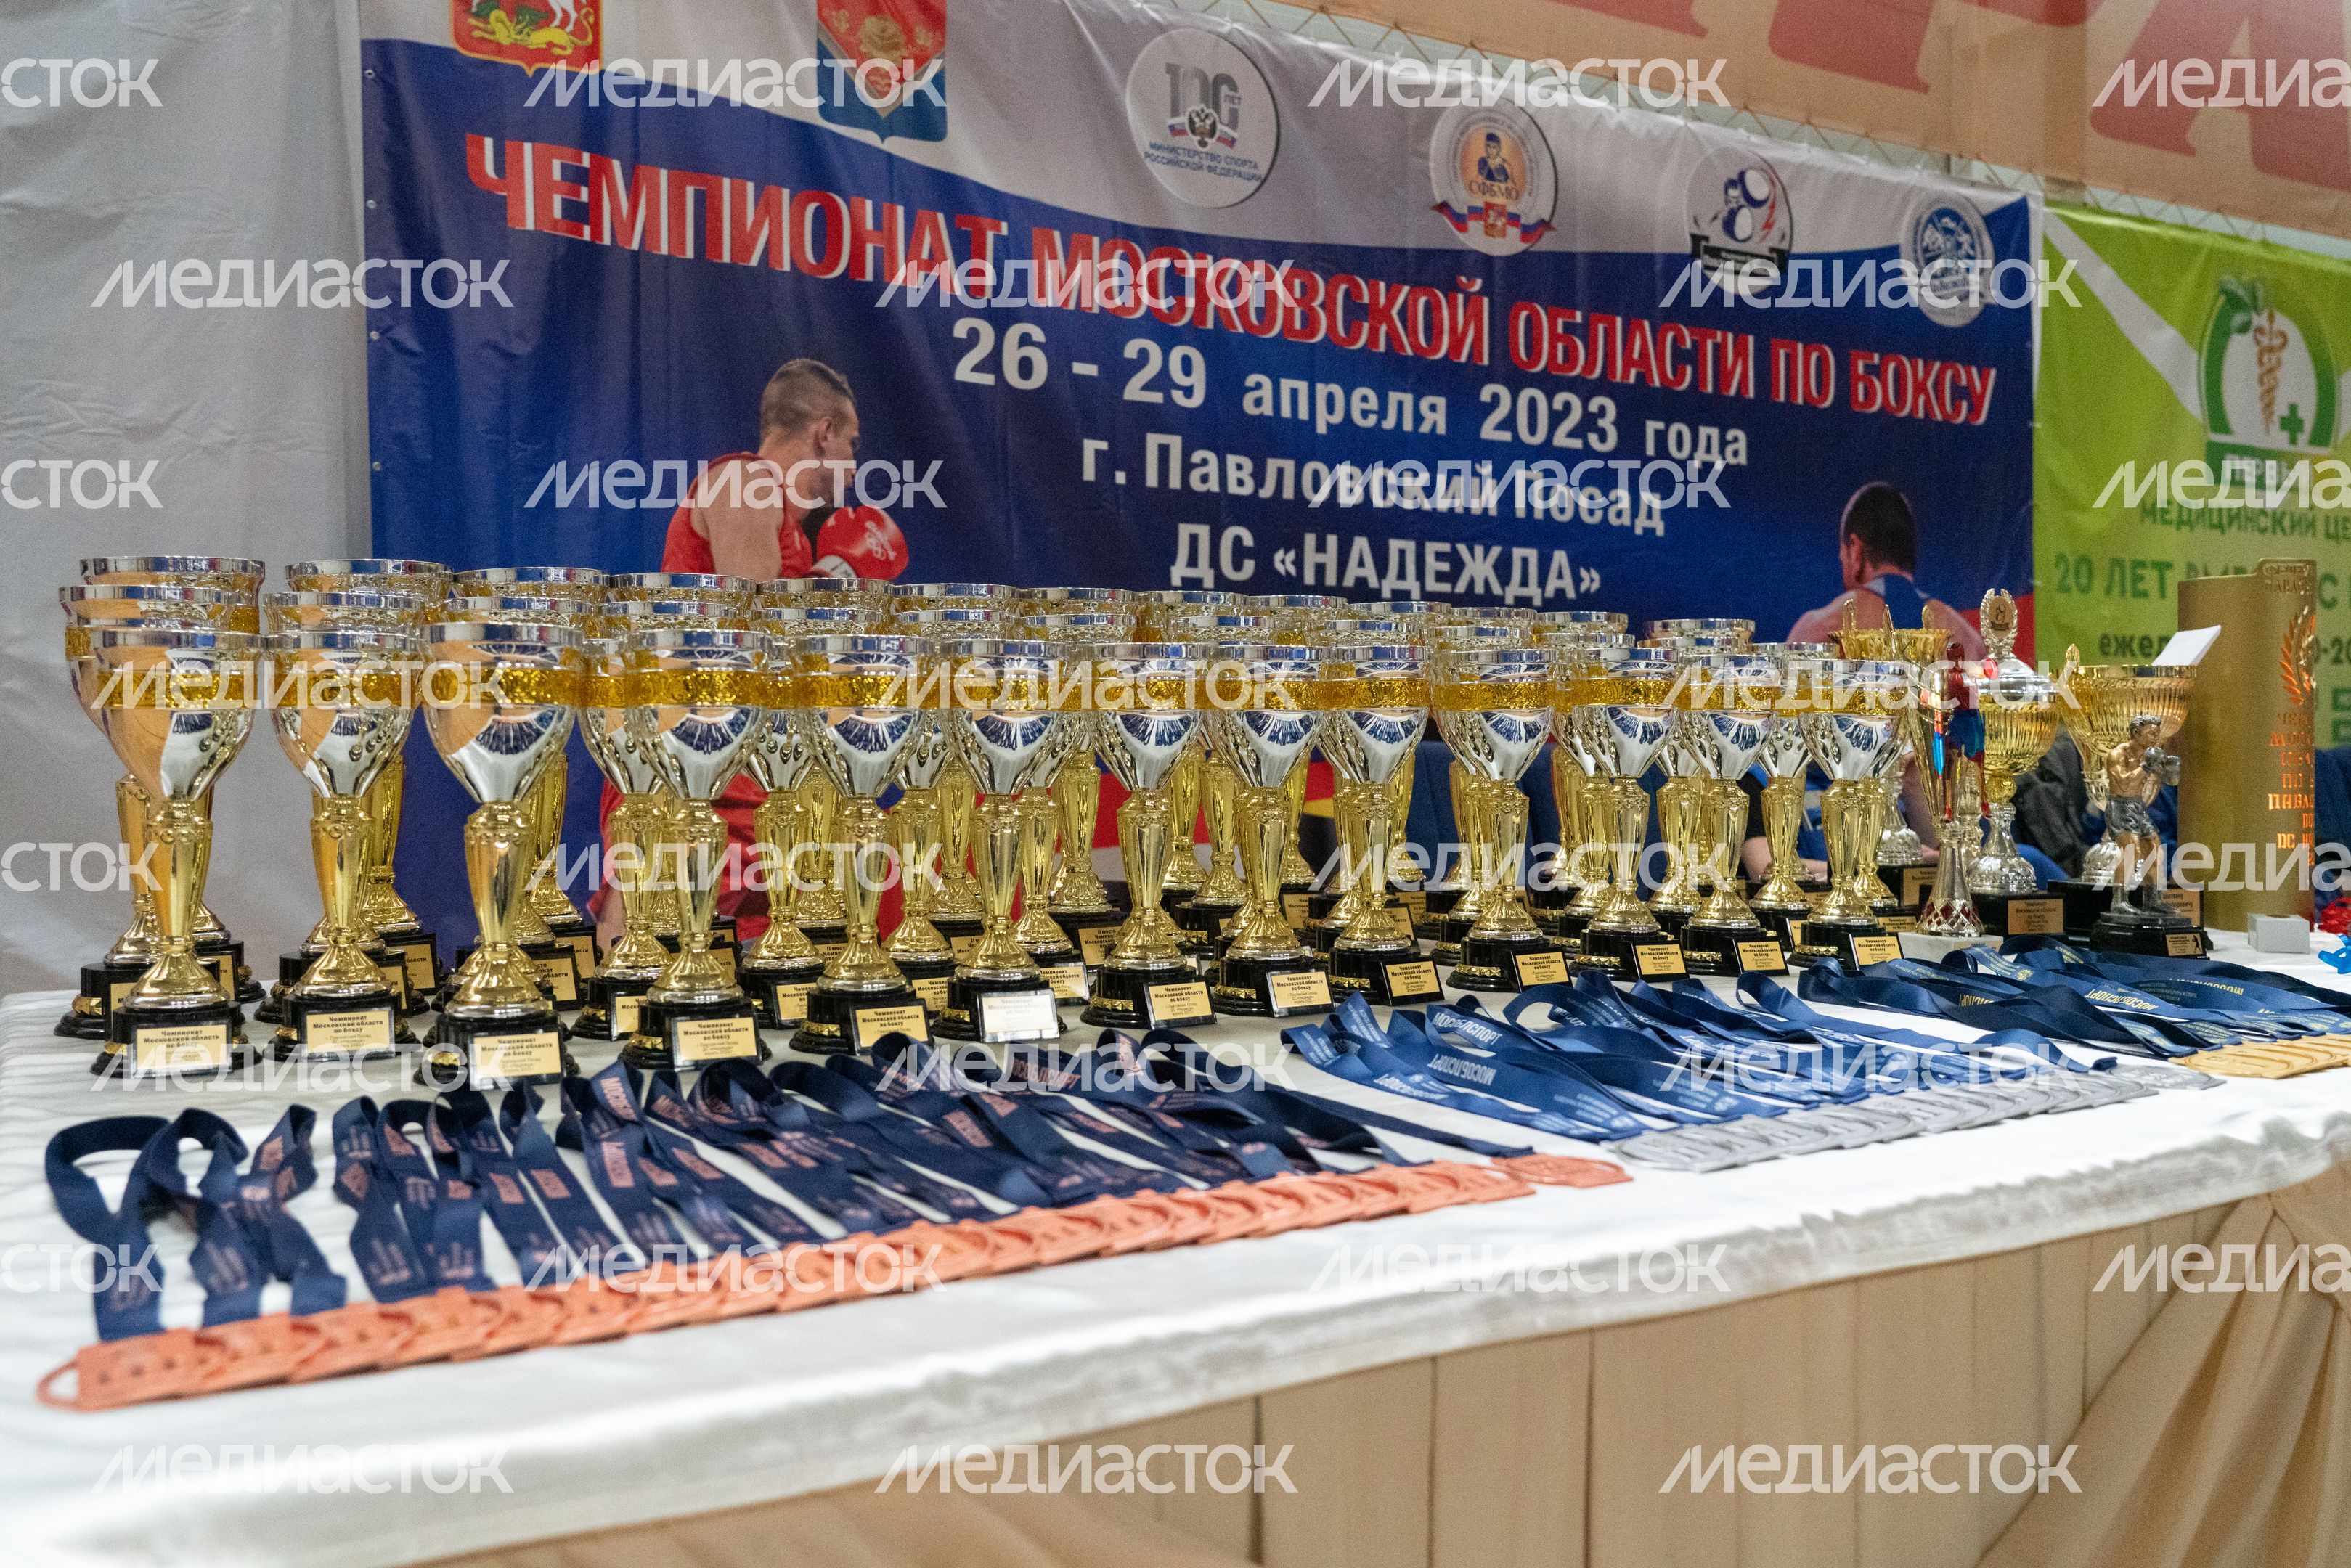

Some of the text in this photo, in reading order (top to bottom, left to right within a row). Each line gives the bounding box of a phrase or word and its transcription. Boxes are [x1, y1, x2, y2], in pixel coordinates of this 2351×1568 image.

[1144, 152, 1262, 181] РОССИЙСКОЙ ФЕДЕРАЦИИ
[1149, 142, 1258, 169] МИНИСТЕРСТВО СПОРТА
[465, 134, 1998, 425] ЧЕМПИОНАТ МОСКОВСКОЙ ОБЛАСТИ ПО БОКСУ
[953, 317, 1048, 391] 26
[1123, 338, 1207, 408] 29
[1242, 372, 1448, 436] апреля
[1480, 385, 1619, 454] 2023
[1645, 419, 1748, 467] года
[1082, 433, 1664, 536] г. Павловский Посад
[1170, 523, 1601, 606] ДС «НАДЕЖДА»
[2054, 552, 2093, 594] 20
[2106, 557, 2174, 600] ЛЕТ
[2085, 989, 2159, 1010] МОСОБЛСПОРТ
[1433, 1012, 1502, 1045] МОСОБЛСПОРТ
